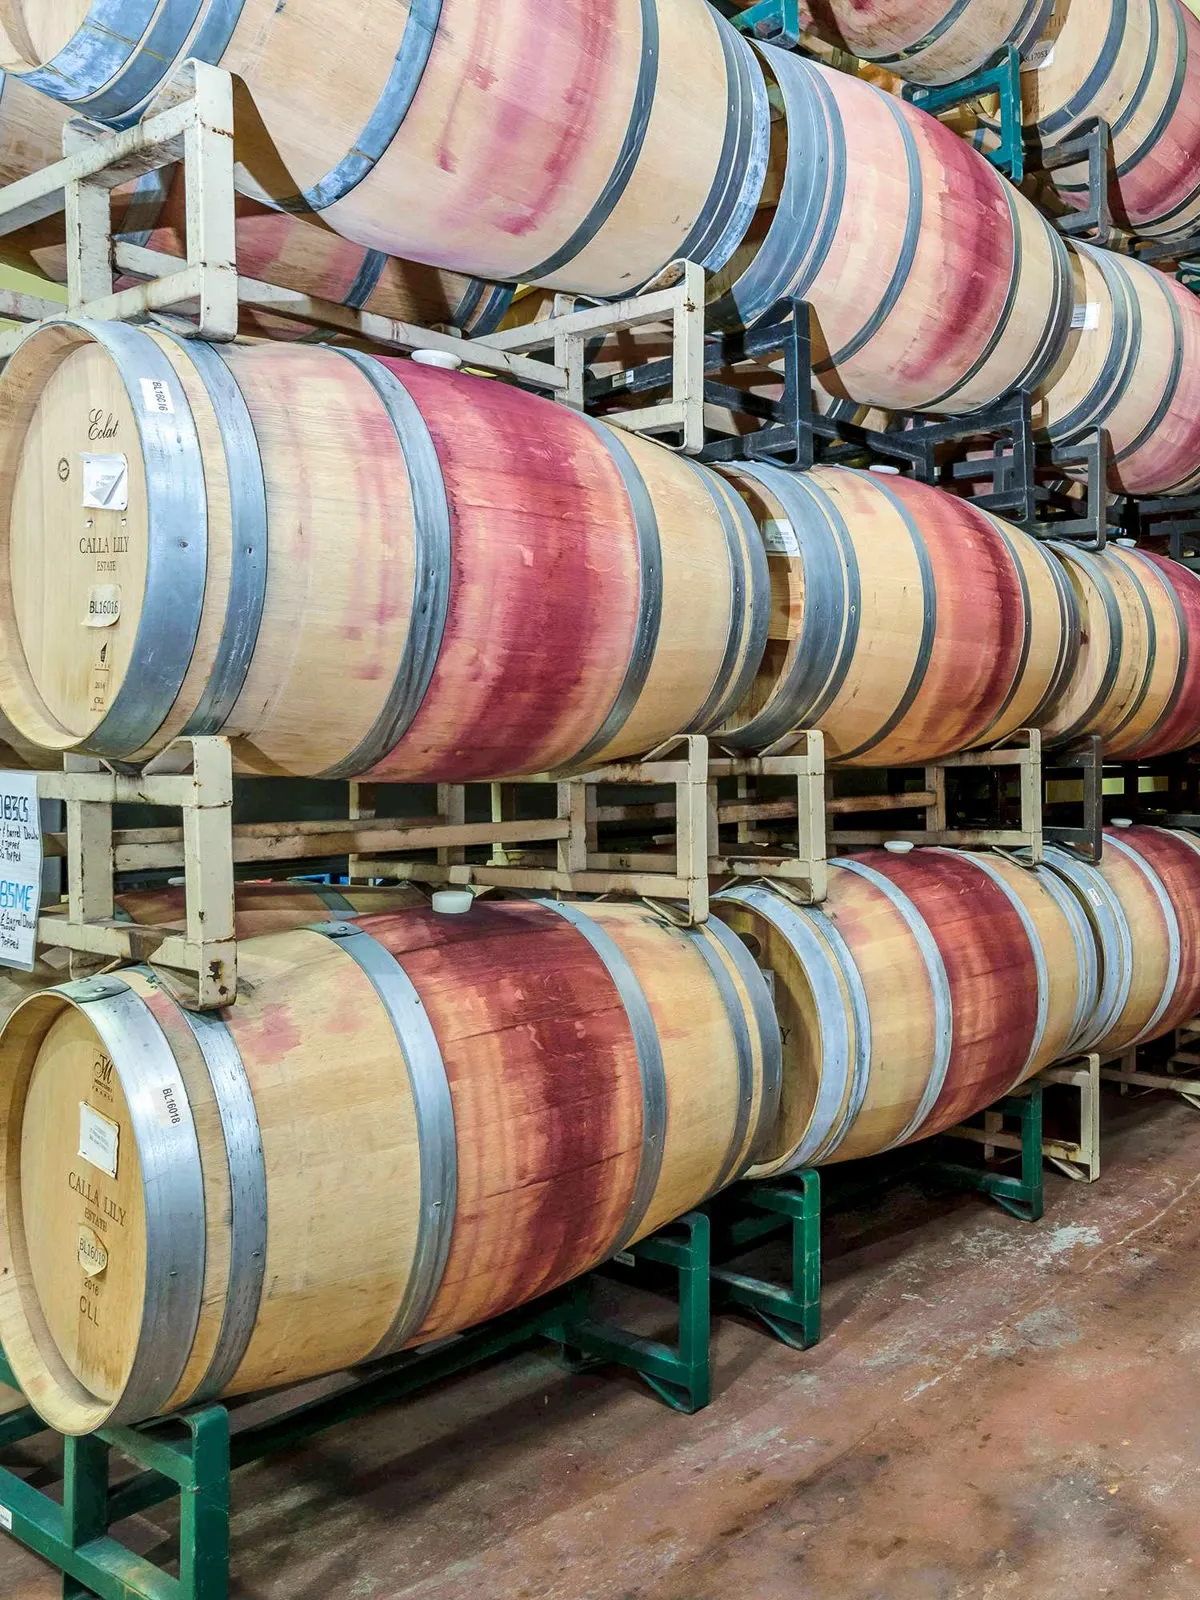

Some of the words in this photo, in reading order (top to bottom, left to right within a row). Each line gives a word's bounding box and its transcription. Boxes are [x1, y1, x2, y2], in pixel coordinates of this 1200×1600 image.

[152, 381, 168, 412] BL16016
[79, 537, 109, 554] CALLA
[113, 536, 130, 553] LILY
[96, 560, 116, 572] ESTATE
[89, 600, 118, 614] BL16016
[162, 1087, 181, 1125] BL16018
[69, 1171, 100, 1208] CALLA
[104, 1196, 127, 1228] LILY
[85, 1207, 107, 1233] ESTATE
[79, 1295, 100, 1328] CLL
